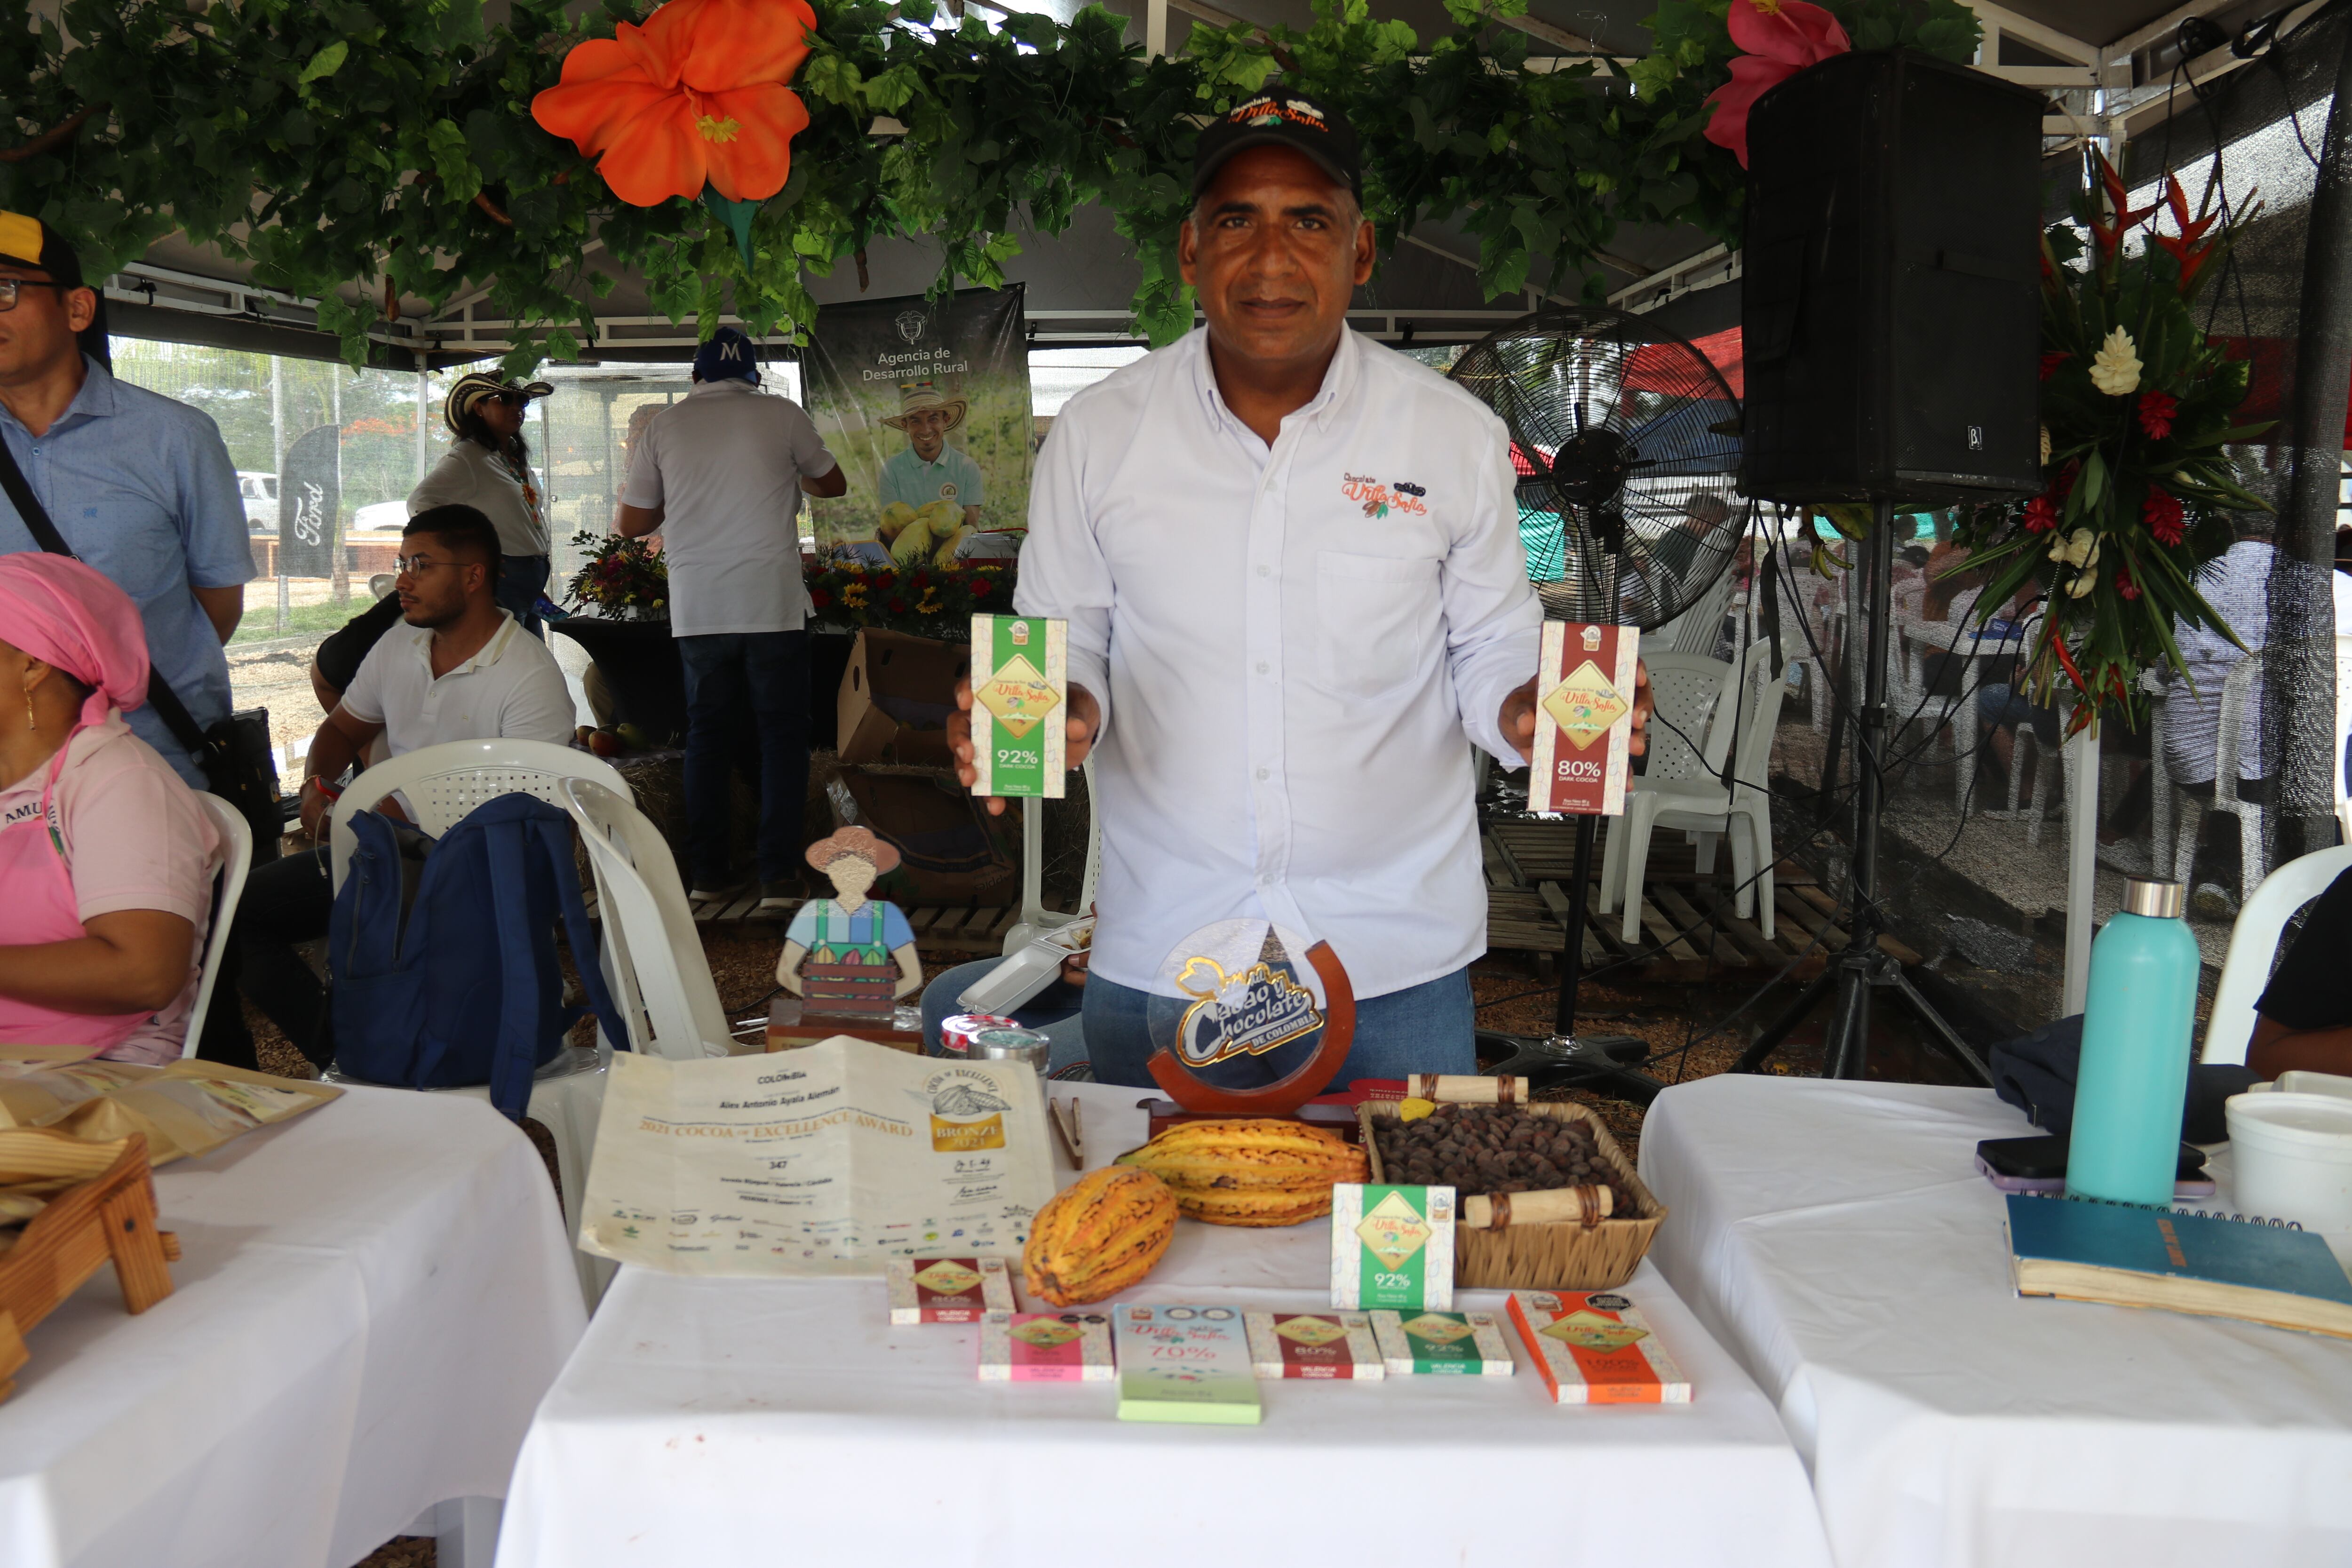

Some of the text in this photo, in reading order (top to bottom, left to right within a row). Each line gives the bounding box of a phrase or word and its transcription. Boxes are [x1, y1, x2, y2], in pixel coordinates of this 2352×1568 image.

[719, 342, 742, 362] M
[878, 347, 951, 366] Agencia de
[863, 360, 968, 382] Desarrollo Rural
[1344, 472, 1376, 484] Chocolate
[1342, 482, 1427, 516] Villa Sofia
[294, 481, 324, 547] Ford
[993, 684, 1050, 703] Villa Sofia
[1559, 691, 1618, 713] Villa Sofia
[997, 749, 1039, 764] 92%
[1557, 760, 1601, 777] 80%
[1251, 1013, 1316, 1047] DE COLOMBIA
[757, 1071, 807, 1084] COLOMBIA
[926, 1075, 944, 1094] COCOA
[955, 1069, 998, 1092] EXCELLENCE
[718, 1101, 740, 1109] Alex
[742, 1098, 778, 1109] Antonio
[779, 1094, 805, 1106] Ayala
[639, 1120, 670, 1136] 2021
[674, 1126, 733, 1138] COCOA
[754, 1111, 852, 1138] EXCELLENCE
[854, 1114, 914, 1138] AWARD
[936, 1126, 997, 1138] BRONZE
[953, 1138, 986, 1148] 2021
[1373, 1219, 1398, 1232] Villa
[1374, 1273, 1411, 1287] 92%
[1124, 1325, 1231, 1341] Villa Sofia
[1148, 1345, 1217, 1359] 70%
[1295, 1346, 1337, 1355] 80%
[1425, 1344, 1464, 1353] 92%
